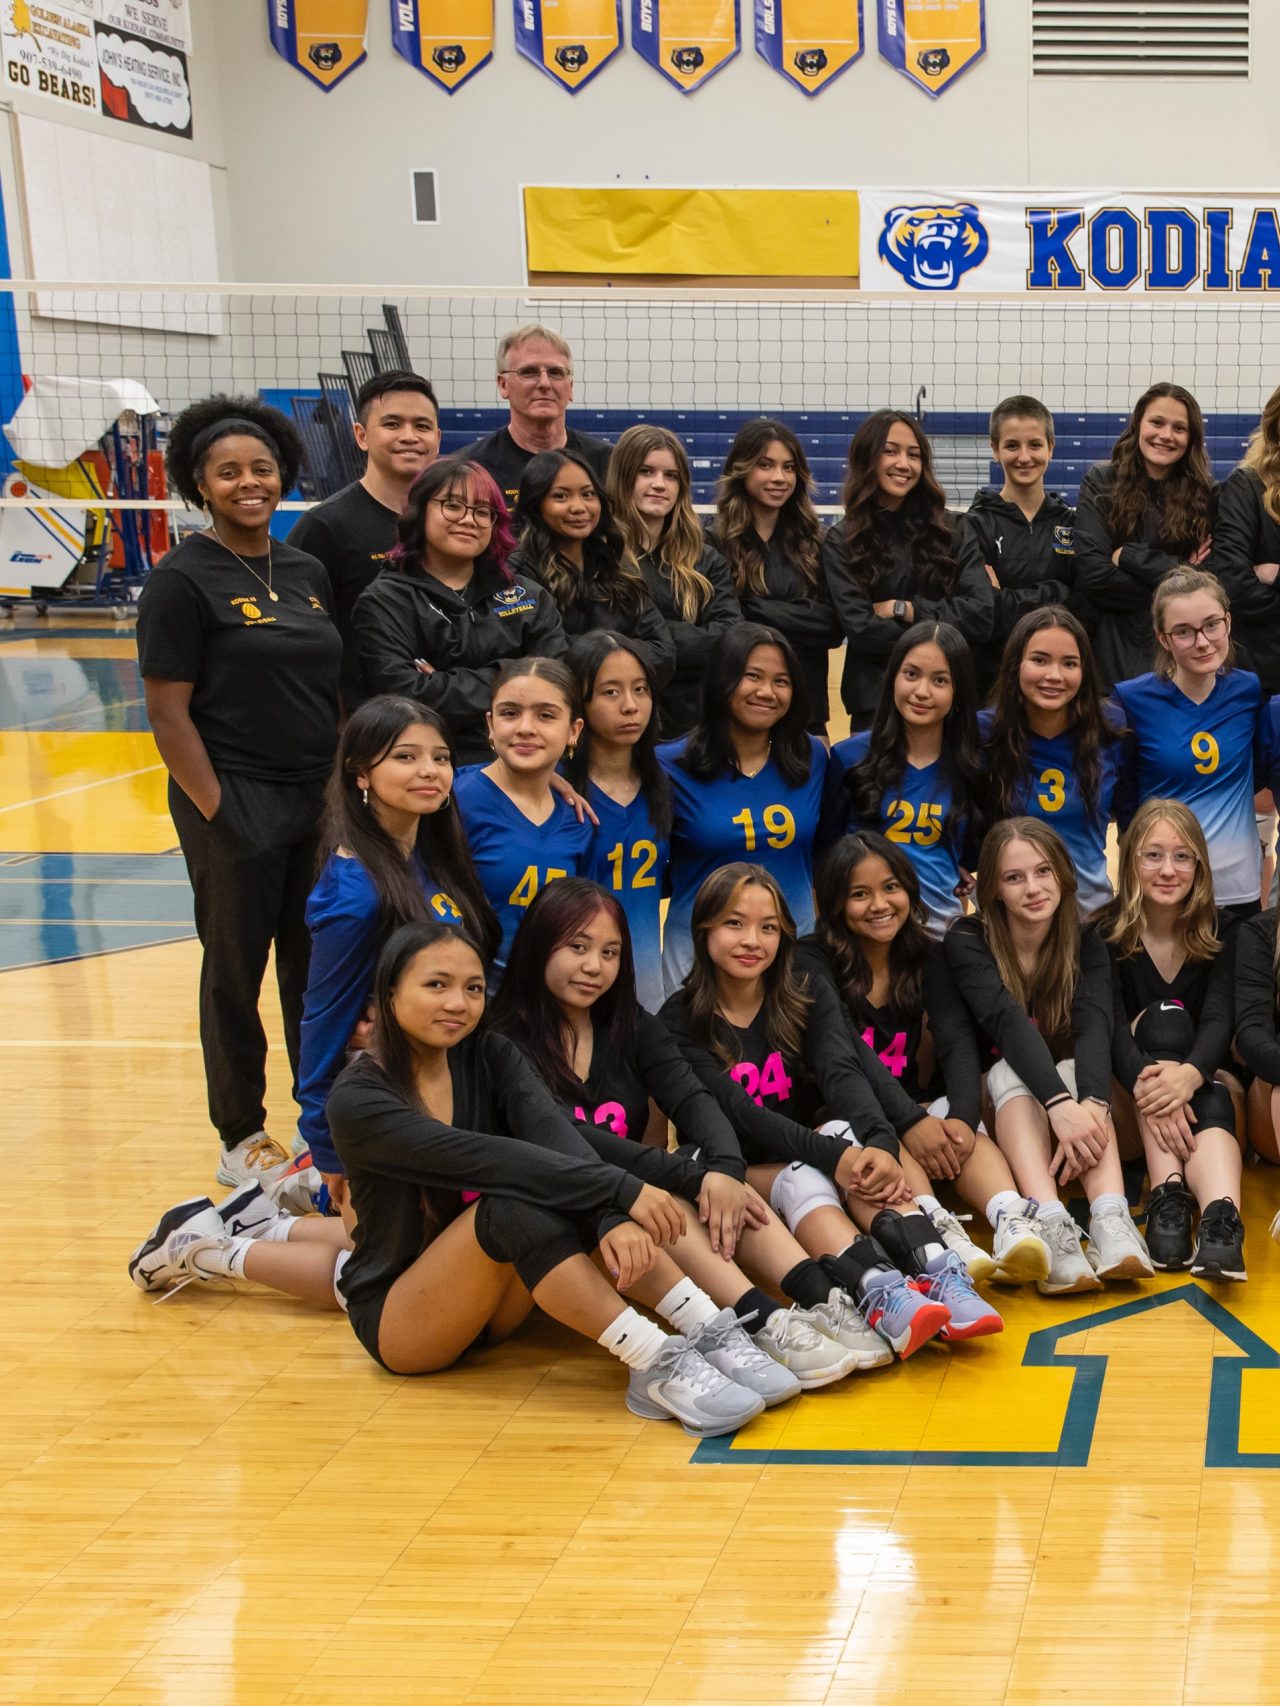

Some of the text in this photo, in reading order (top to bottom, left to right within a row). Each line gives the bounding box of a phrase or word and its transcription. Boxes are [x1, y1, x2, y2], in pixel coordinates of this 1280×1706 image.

[124, 4, 138, 20] WE
[141, 10, 168, 32] SERVE
[524, 1, 535, 31] BOYS
[8, 60, 30, 86] GO
[38, 69, 97, 109] BEARS!
[1190, 731, 1220, 775] 9
[1038, 768, 1066, 812] 3
[732, 803, 796, 851] 19
[883, 800, 943, 846] 25
[607, 839, 658, 891] 12
[730, 1051, 793, 1108] 24
[574, 1101, 629, 1140] 3
